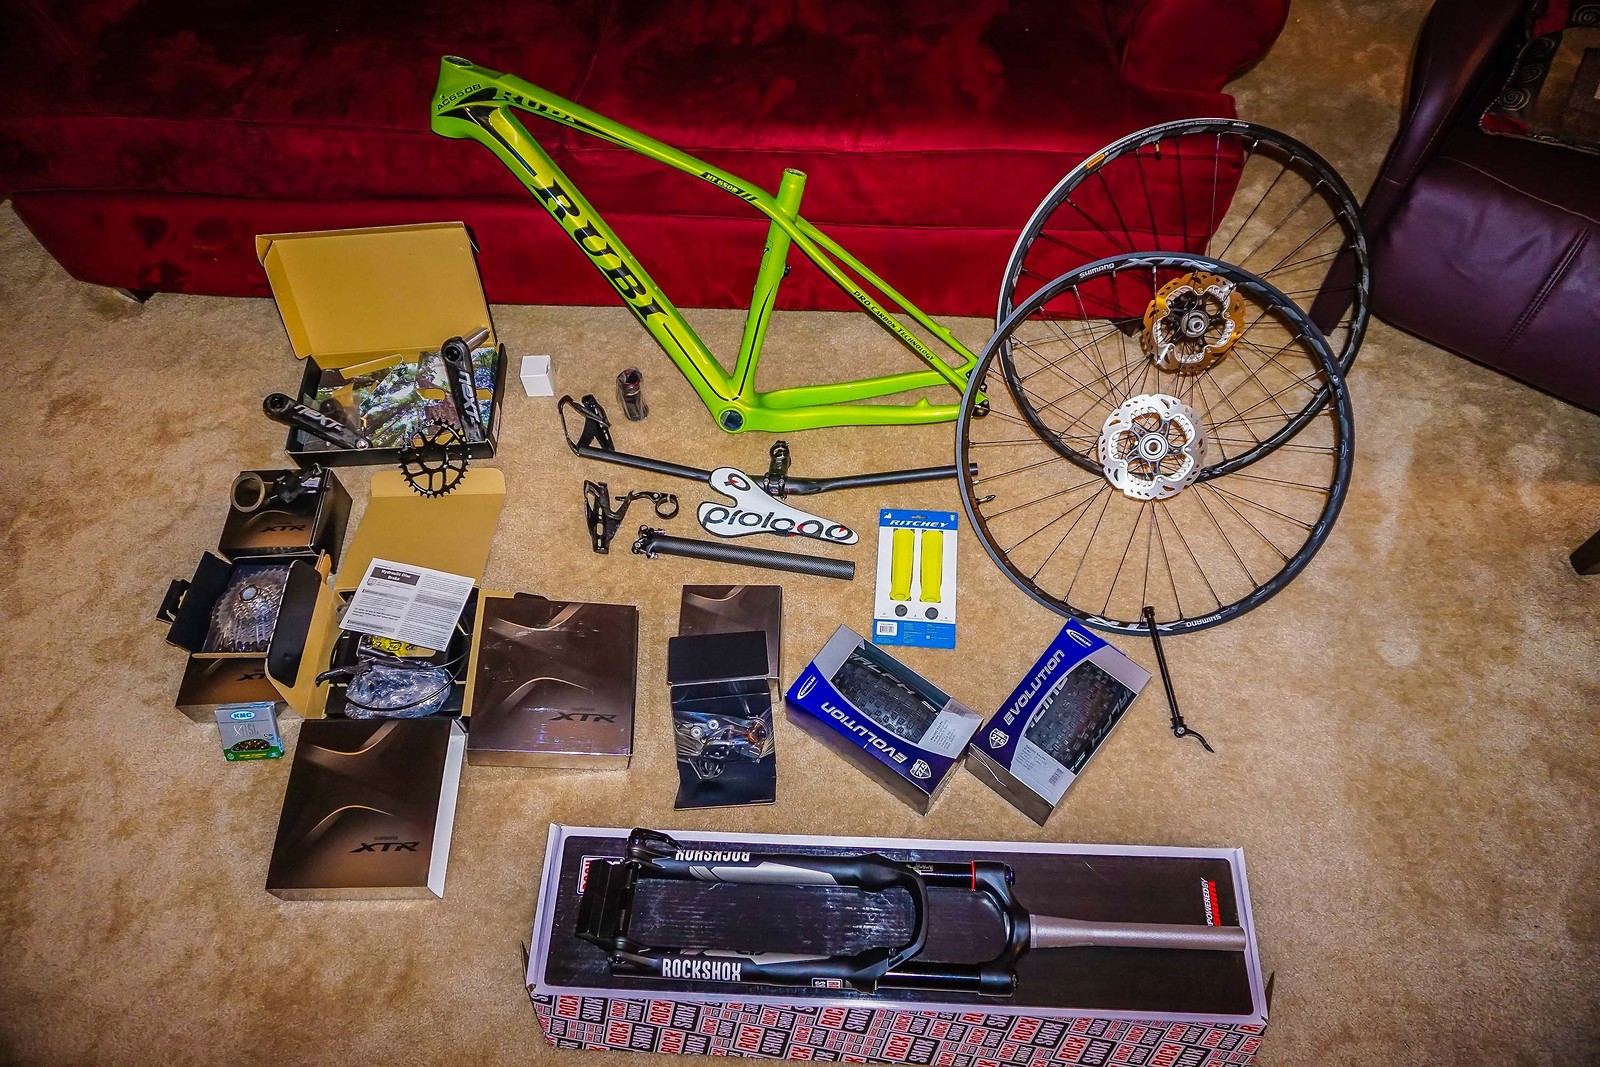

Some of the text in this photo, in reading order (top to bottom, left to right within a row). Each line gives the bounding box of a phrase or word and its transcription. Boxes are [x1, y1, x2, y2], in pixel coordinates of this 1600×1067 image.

[530, 178, 669, 322] RUBI
[1080, 262, 1115, 278] SHIMANO
[853, 291, 871, 306] PRO
[890, 520, 948, 528] RITCHEY
[1186, 614, 1222, 628] SHIMANO
[1004, 650, 1065, 726] EVOLUTION
[549, 712, 617, 723] XTR
[820, 702, 908, 764] EVOLUTION
[349, 842, 420, 853] XTR
[662, 958, 741, 981] ROCKSHOX
[558, 996, 604, 1021] ROCK SHOX
[650, 1000, 696, 1028] ROCK SHOX
[762, 1008, 778, 1025] ROCK
[821, 1007, 845, 1026] ROC
[895, 1016, 911, 1032] ROCK
[931, 1022, 948, 1038] ROCK
[1011, 1018, 1064, 1046] ROCK SHOX
[608, 1021, 629, 1045] ROCK
[632, 1026, 654, 1049] SHOX
[738, 1026, 785, 1054] ROCK SHOX
[794, 1026, 810, 1042] ROCK
[885, 1036, 911, 1058] ROCK
[908, 1039, 935, 1063] SHOX
[1000, 1044, 1017, 1060] ROCK
[1059, 1037, 1112, 1064] ROCK SHOX
[1114, 1045, 1133, 1061] ROCK
[1152, 1044, 1181, 1067] ROCK
